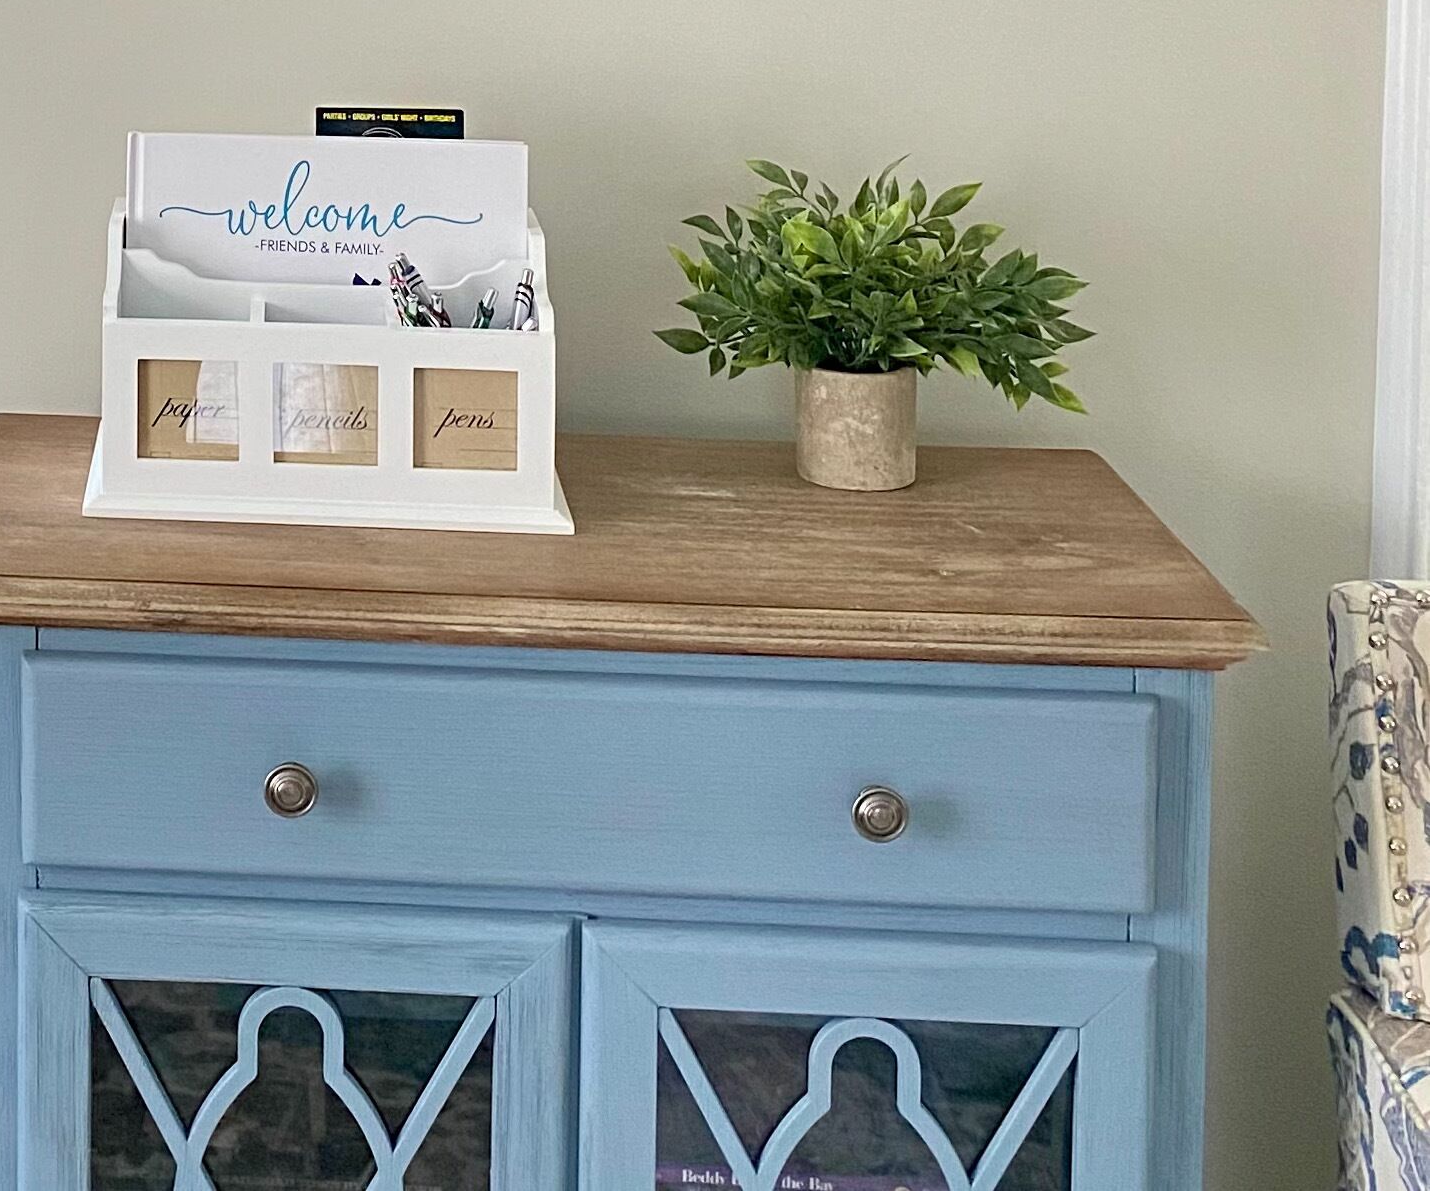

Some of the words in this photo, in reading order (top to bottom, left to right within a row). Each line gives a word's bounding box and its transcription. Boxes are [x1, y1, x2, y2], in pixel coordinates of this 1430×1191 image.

[159, 160, 484, 237] welcome
[320, 241, 330, 254] &
[152, 396, 226, 427] paper
[286, 406, 369, 432] pencils
[433, 408, 496, 438] pens
[781, 1175, 804, 1189] the
